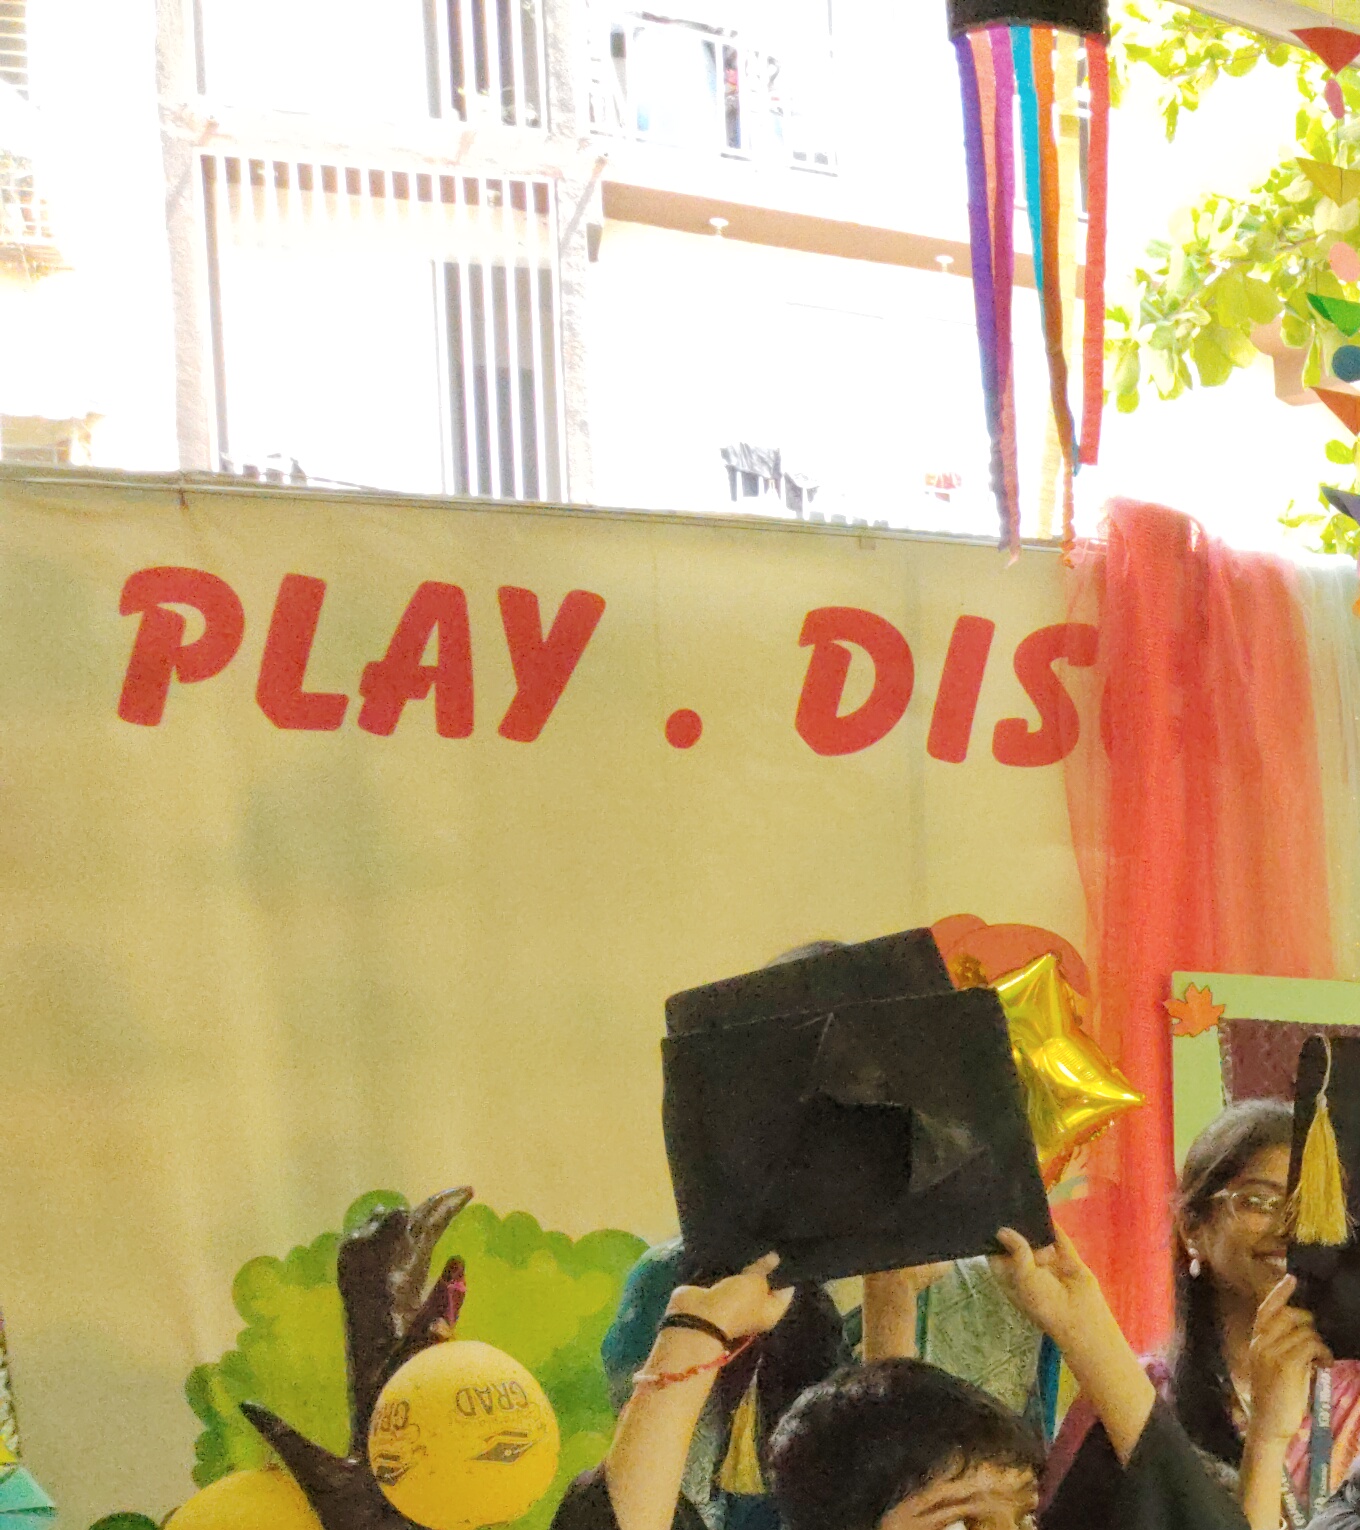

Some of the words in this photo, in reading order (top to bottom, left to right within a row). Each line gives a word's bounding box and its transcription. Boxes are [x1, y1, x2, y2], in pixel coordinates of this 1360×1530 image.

[117, 566, 606, 742] PLAY
[796, 606, 1099, 768] DIS
[456, 1380, 529, 1417] GRAD
